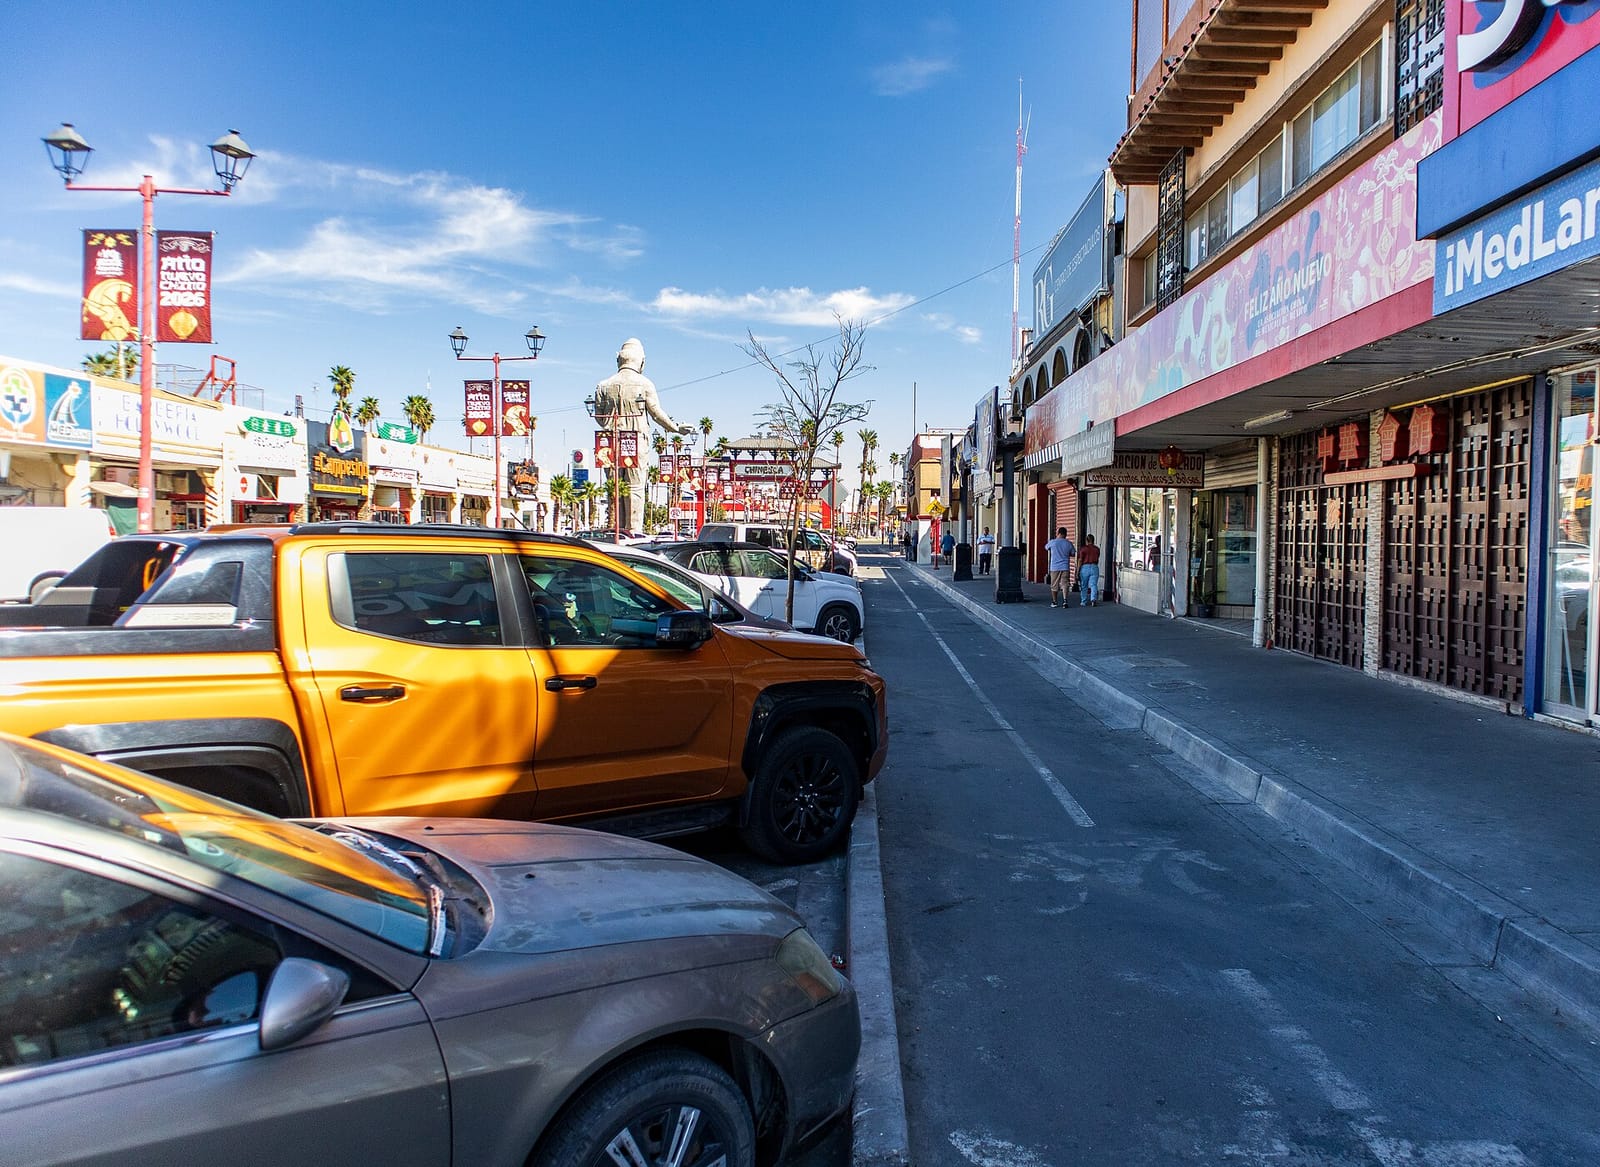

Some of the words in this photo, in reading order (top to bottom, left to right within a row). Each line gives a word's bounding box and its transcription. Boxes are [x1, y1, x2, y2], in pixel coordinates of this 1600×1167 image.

[1244, 290, 1269, 322] FELIZ
[1269, 273, 1292, 309] AÑO
[1293, 252, 1332, 296] NUEVO
[160, 291, 206, 307] 2026
[1035, 261, 1054, 339] RG
[744, 464, 784, 475] CHINESCA
[1148, 456, 1157, 470] de
